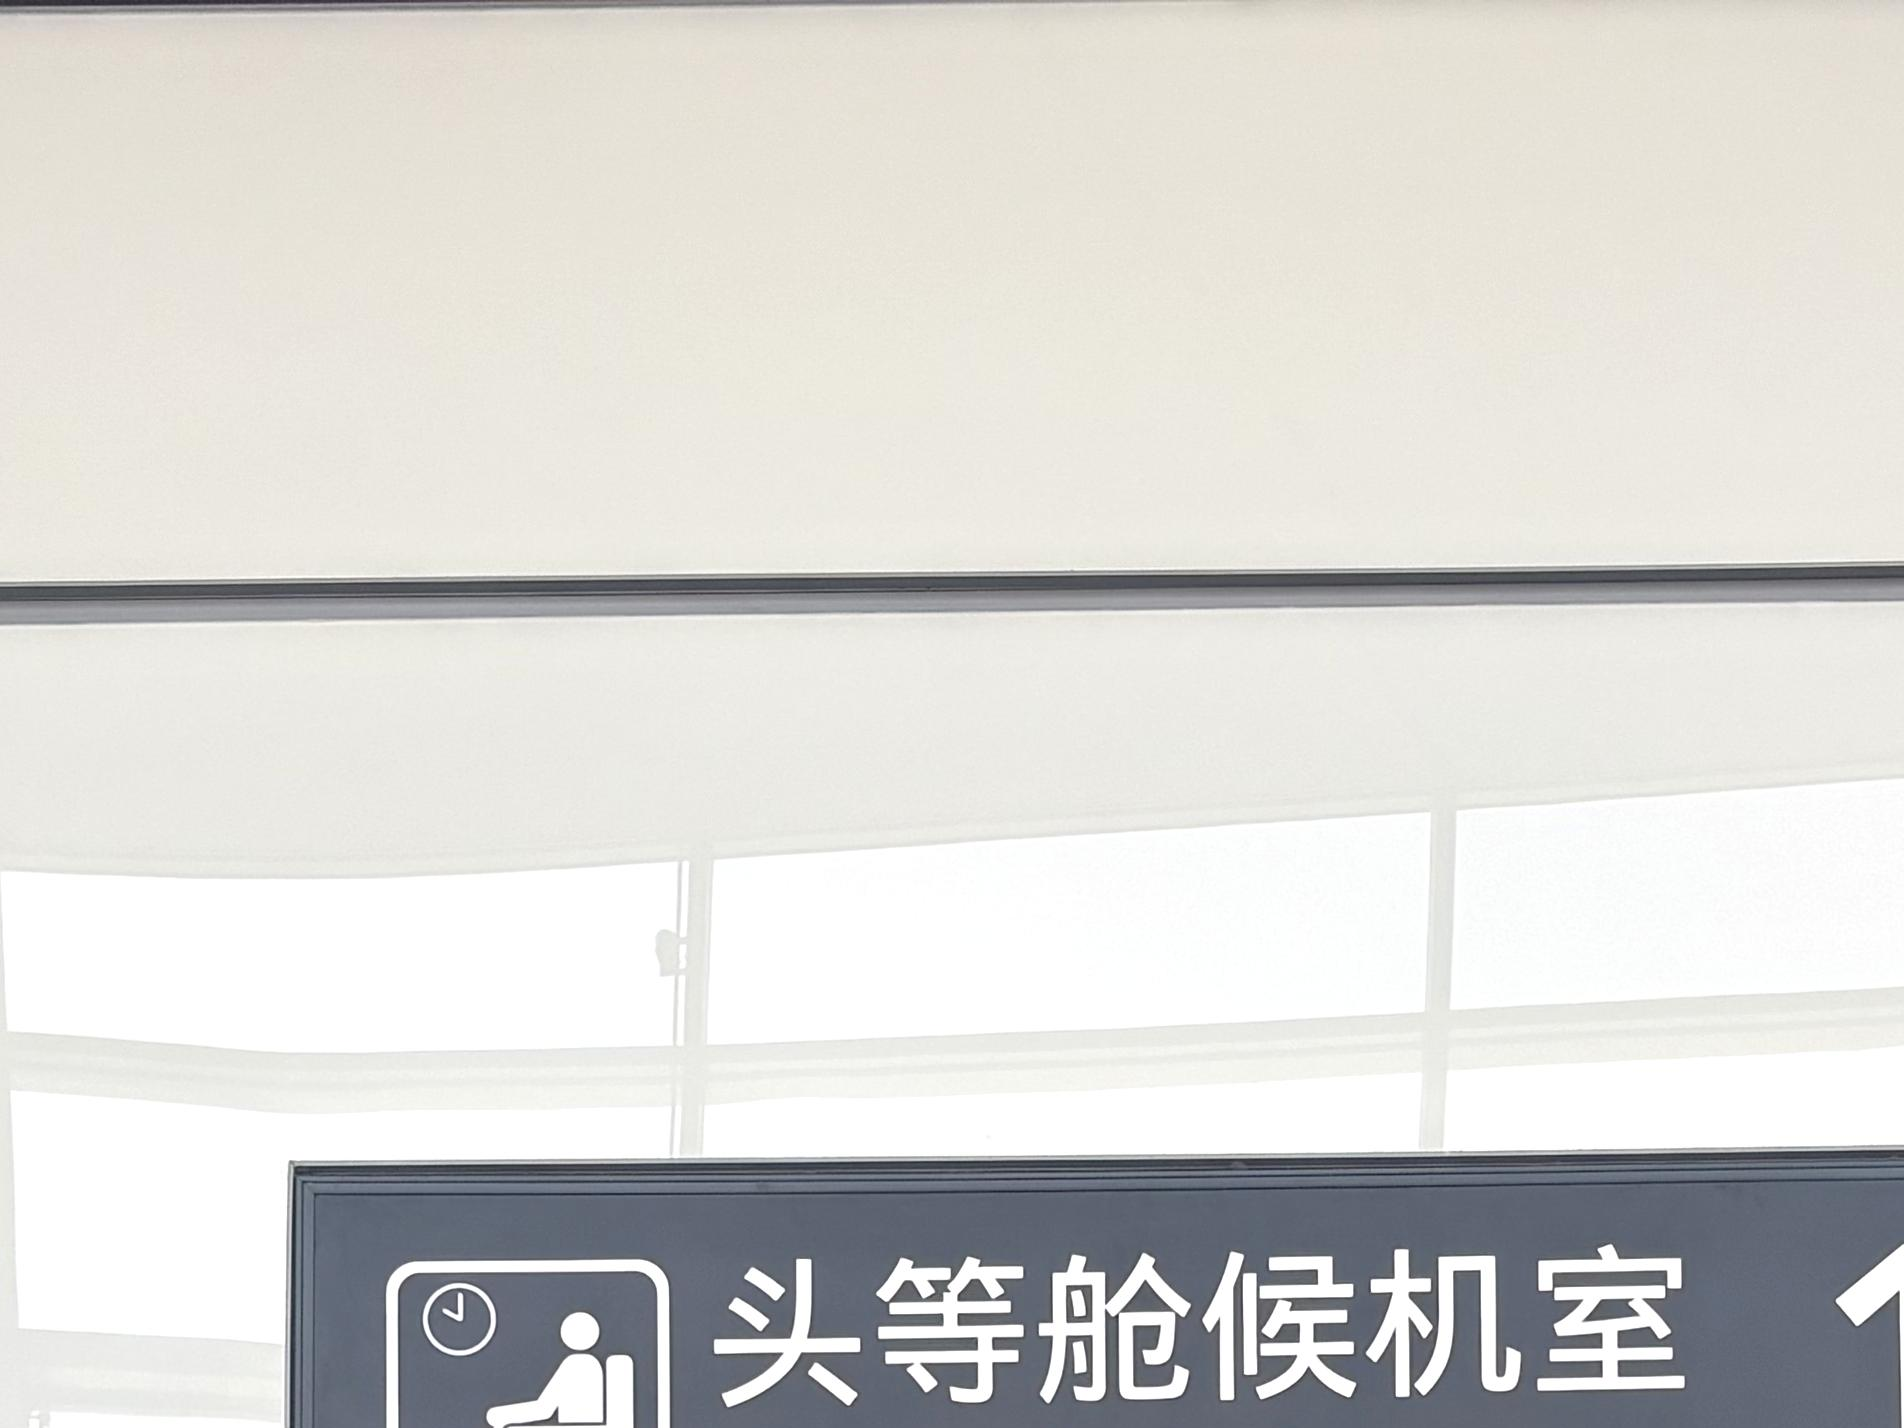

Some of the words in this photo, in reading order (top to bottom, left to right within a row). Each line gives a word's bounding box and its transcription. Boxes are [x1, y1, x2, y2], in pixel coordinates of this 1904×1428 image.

[714, 1245, 1685, 1407] 头等舱候机室
